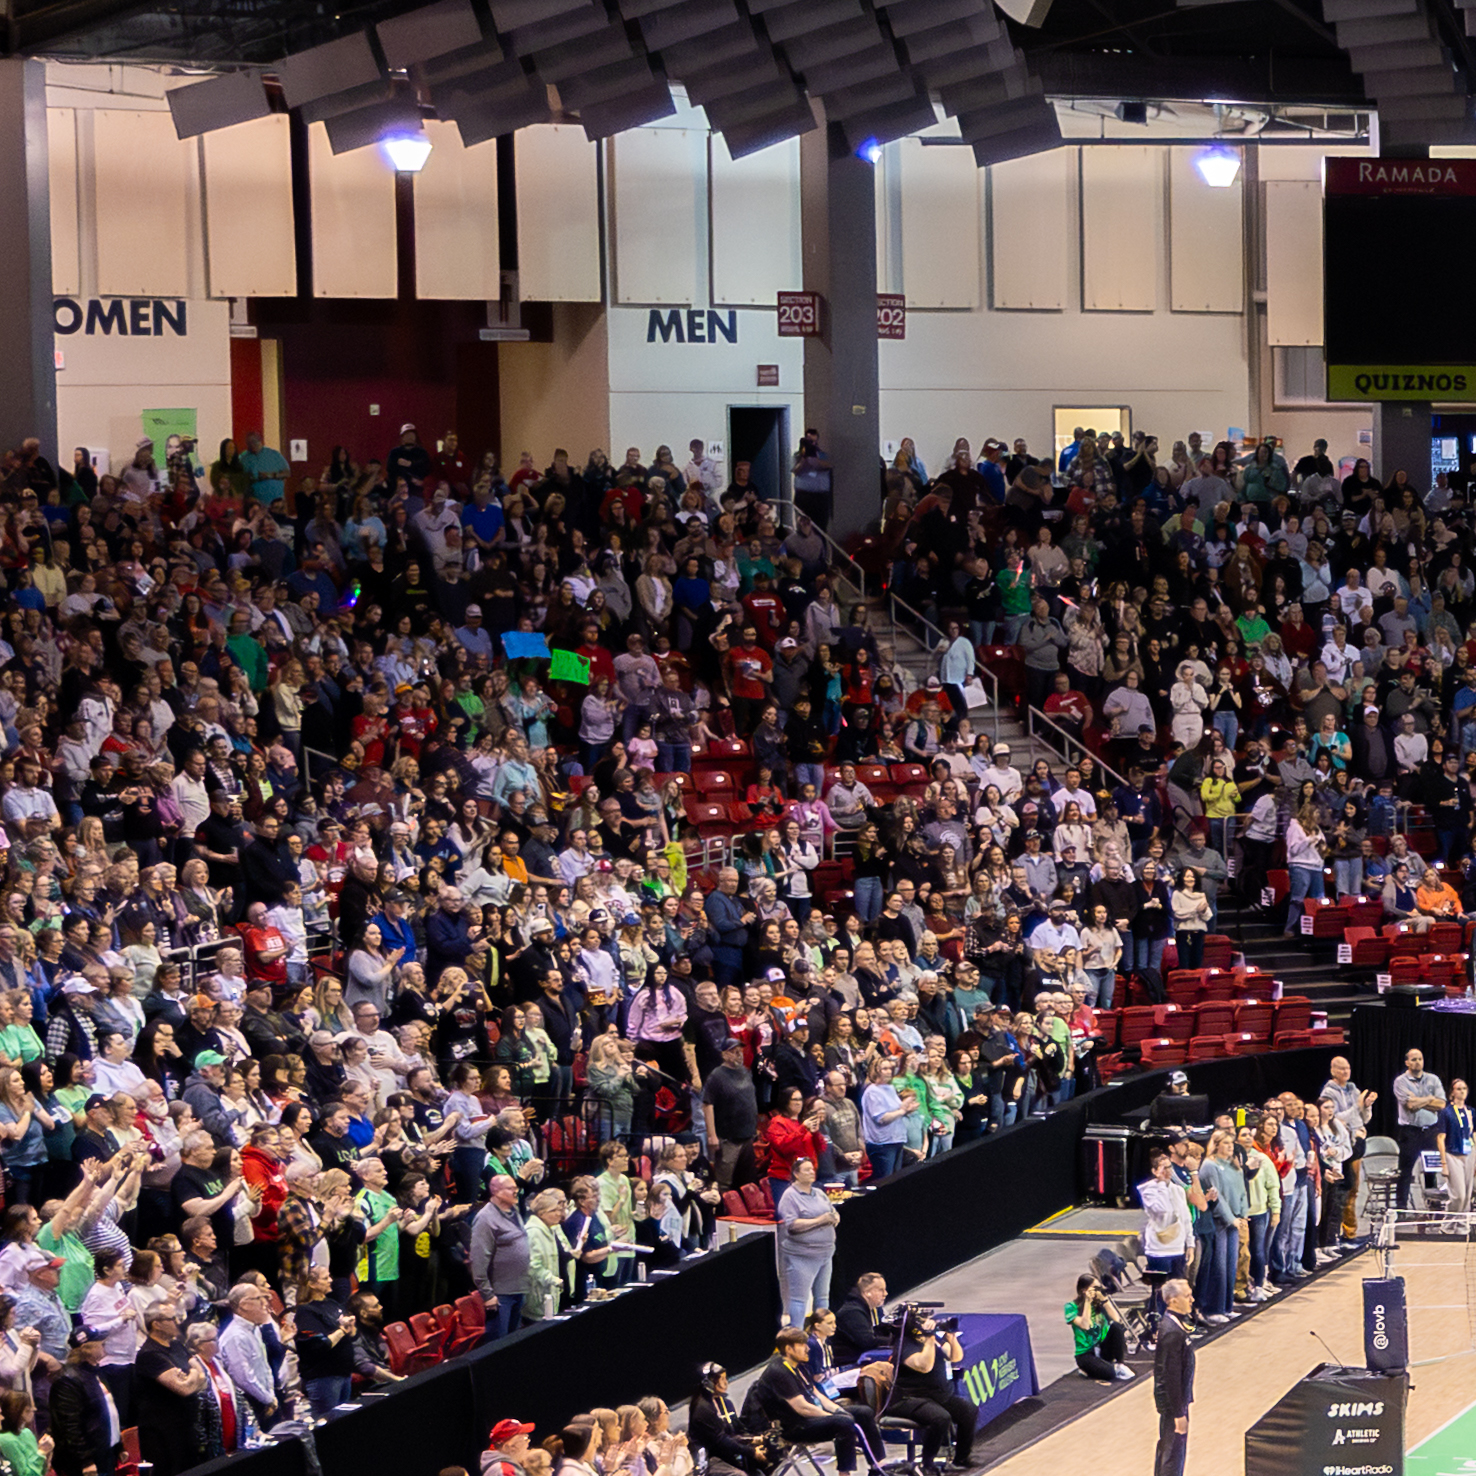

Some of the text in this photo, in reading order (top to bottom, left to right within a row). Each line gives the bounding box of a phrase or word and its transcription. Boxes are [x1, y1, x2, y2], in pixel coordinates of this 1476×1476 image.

[1359, 162, 1457, 183] RAMADA
[53, 298, 187, 336] OMEN
[779, 305, 814, 323] 203
[646, 309, 738, 344] MEN
[1354, 373, 1467, 394] QUIZNOS
[1372, 1304, 1389, 1350] @lovb
[1327, 1402, 1385, 1418] SKIMS
[1346, 1429, 1380, 1438] ATHLETIC
[1335, 1464, 1394, 1476] iHeartRadio
